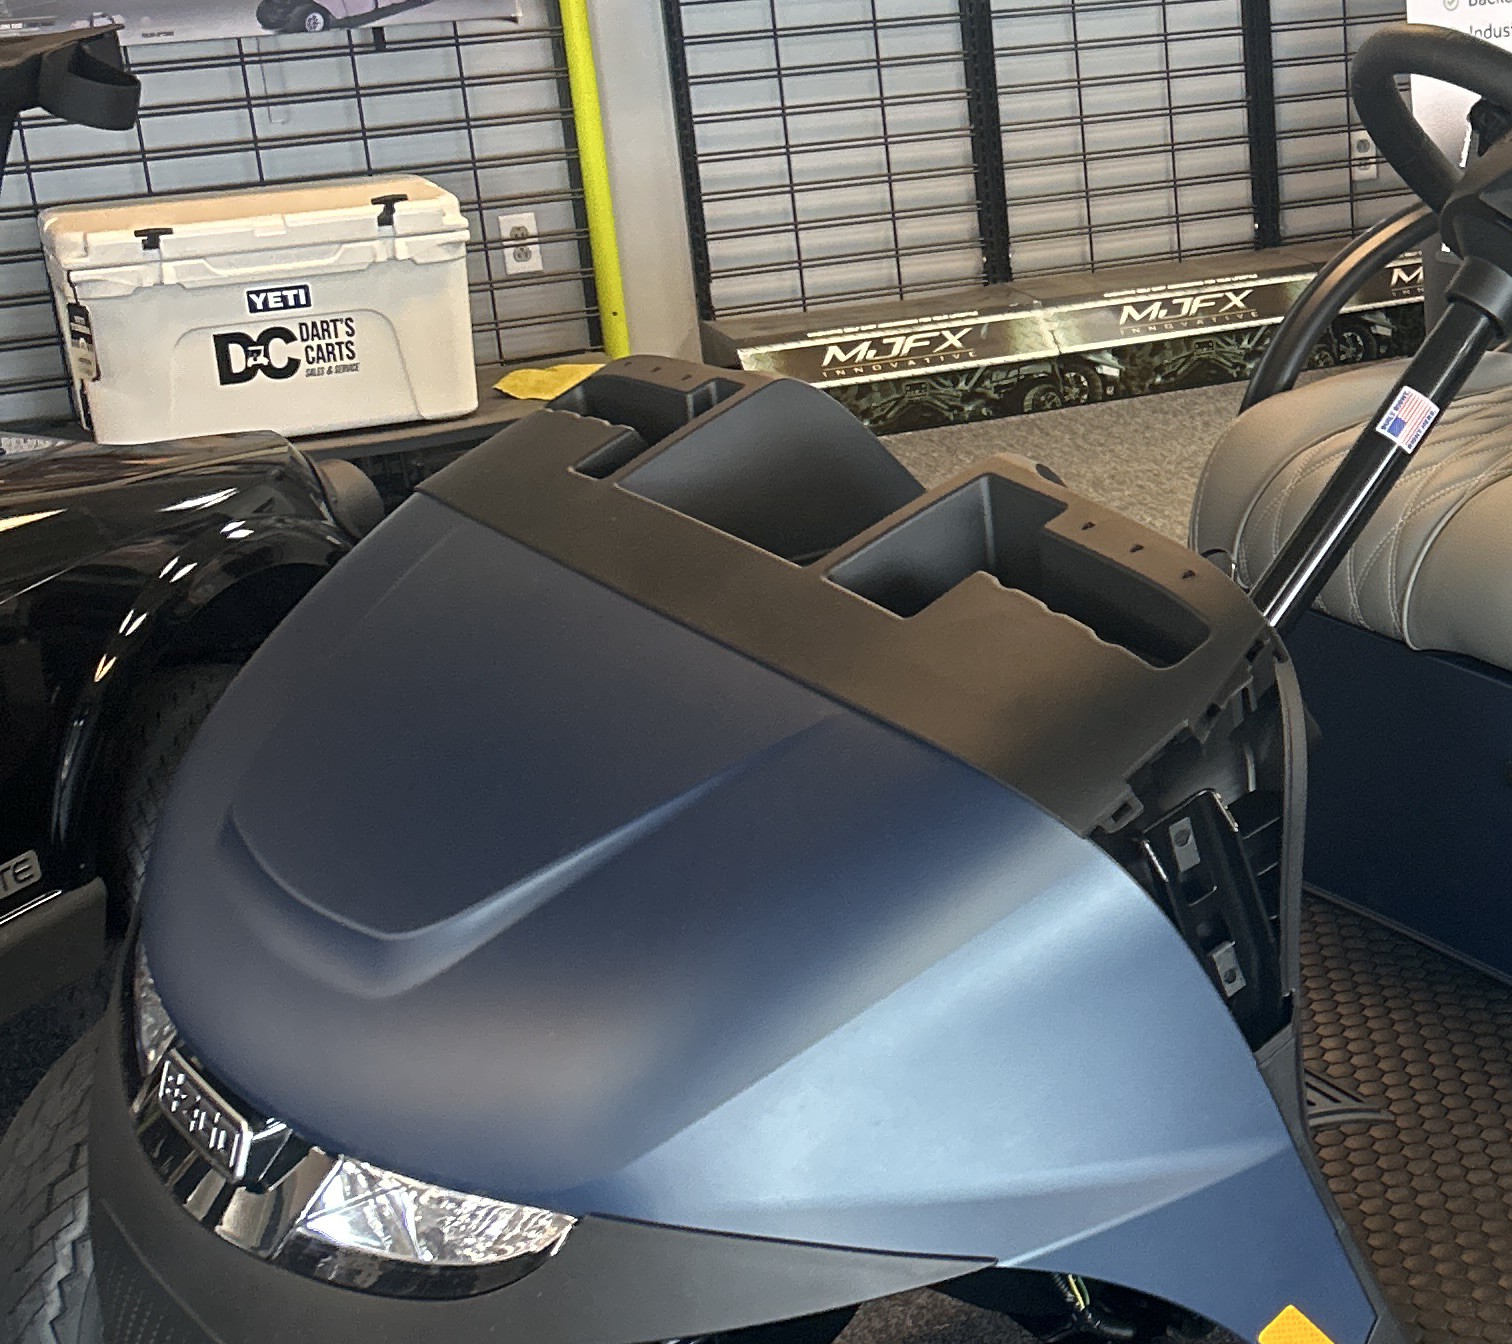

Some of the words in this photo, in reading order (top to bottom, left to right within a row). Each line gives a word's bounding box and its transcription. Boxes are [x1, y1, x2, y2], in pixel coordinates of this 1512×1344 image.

[248, 287, 308, 311] YETI
[298, 316, 356, 343] DART'S
[304, 340, 357, 365] CARTS
[822, 350, 977, 378] INNOVATIVE
